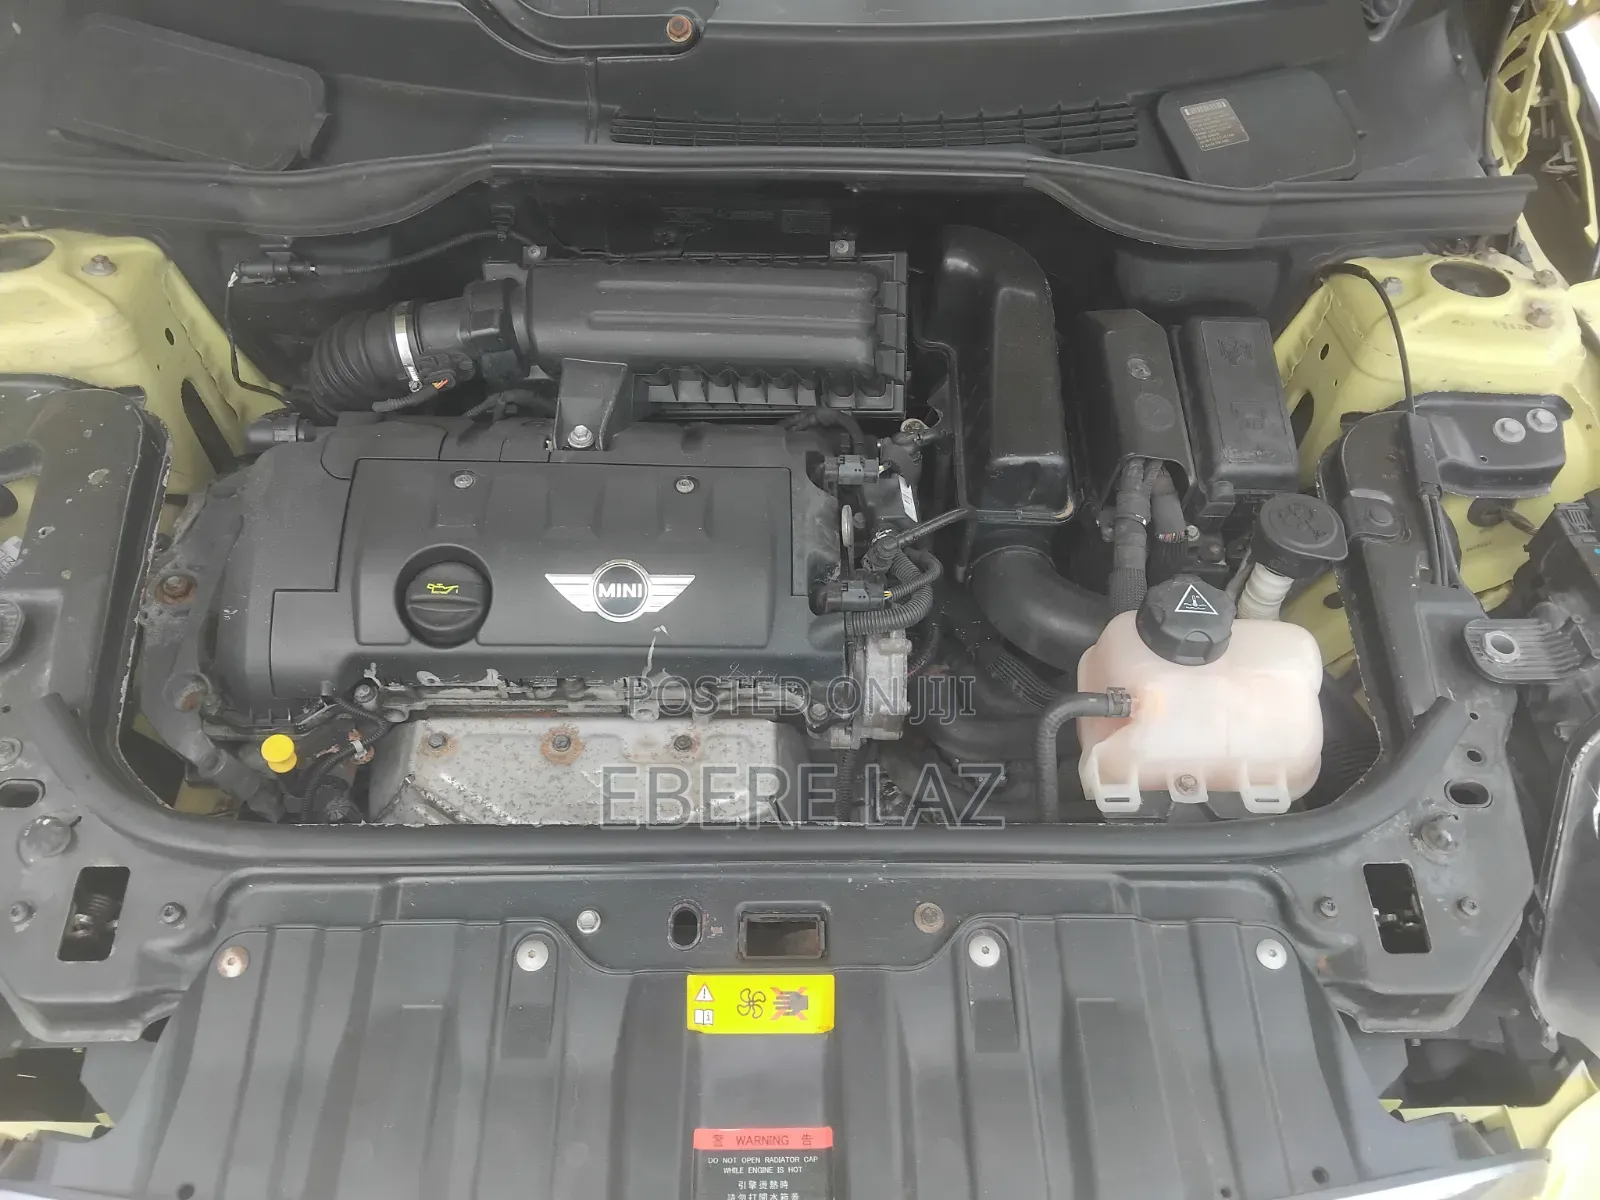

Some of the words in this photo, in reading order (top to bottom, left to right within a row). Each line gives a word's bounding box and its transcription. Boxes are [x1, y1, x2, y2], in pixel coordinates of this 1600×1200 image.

[598, 582, 643, 598] MINI
[736, 1135, 789, 1146] WARNING
[801, 1134, 813, 1146] 告
[764, 1156, 800, 1164] RADIATOR
[723, 1166, 744, 1174] WHILE
[748, 1166, 774, 1174] ENGINE
[777, 1166, 785, 1174] IS
